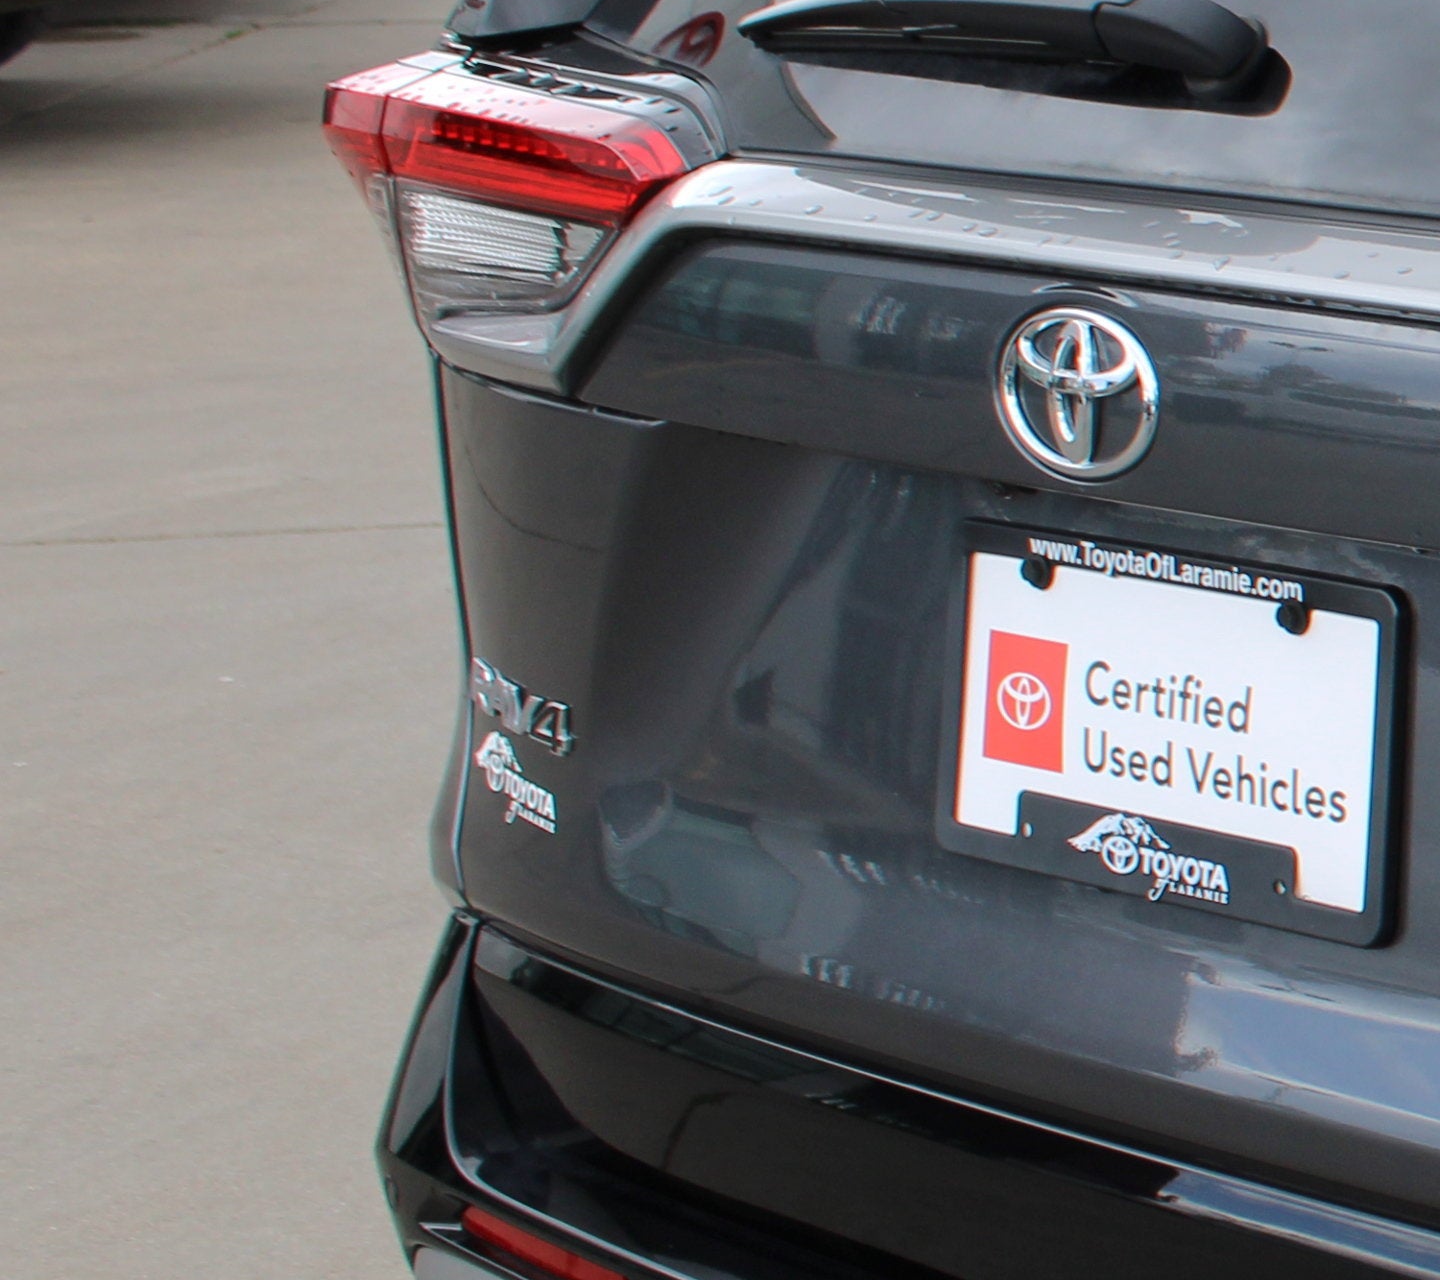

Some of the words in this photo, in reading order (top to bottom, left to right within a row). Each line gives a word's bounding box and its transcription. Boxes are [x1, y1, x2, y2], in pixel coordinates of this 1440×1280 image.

[1030, 537, 1303, 602] www.ToyotaOfLaramie.com
[1085, 660, 1253, 734] Certified
[504, 768, 556, 822] TOYOTA
[1083, 727, 1174, 788] Used
[1186, 747, 1347, 823] Vehicles
[1140, 846, 1229, 892] TOYOTA
[1168, 881, 1229, 905] LARAMIE
